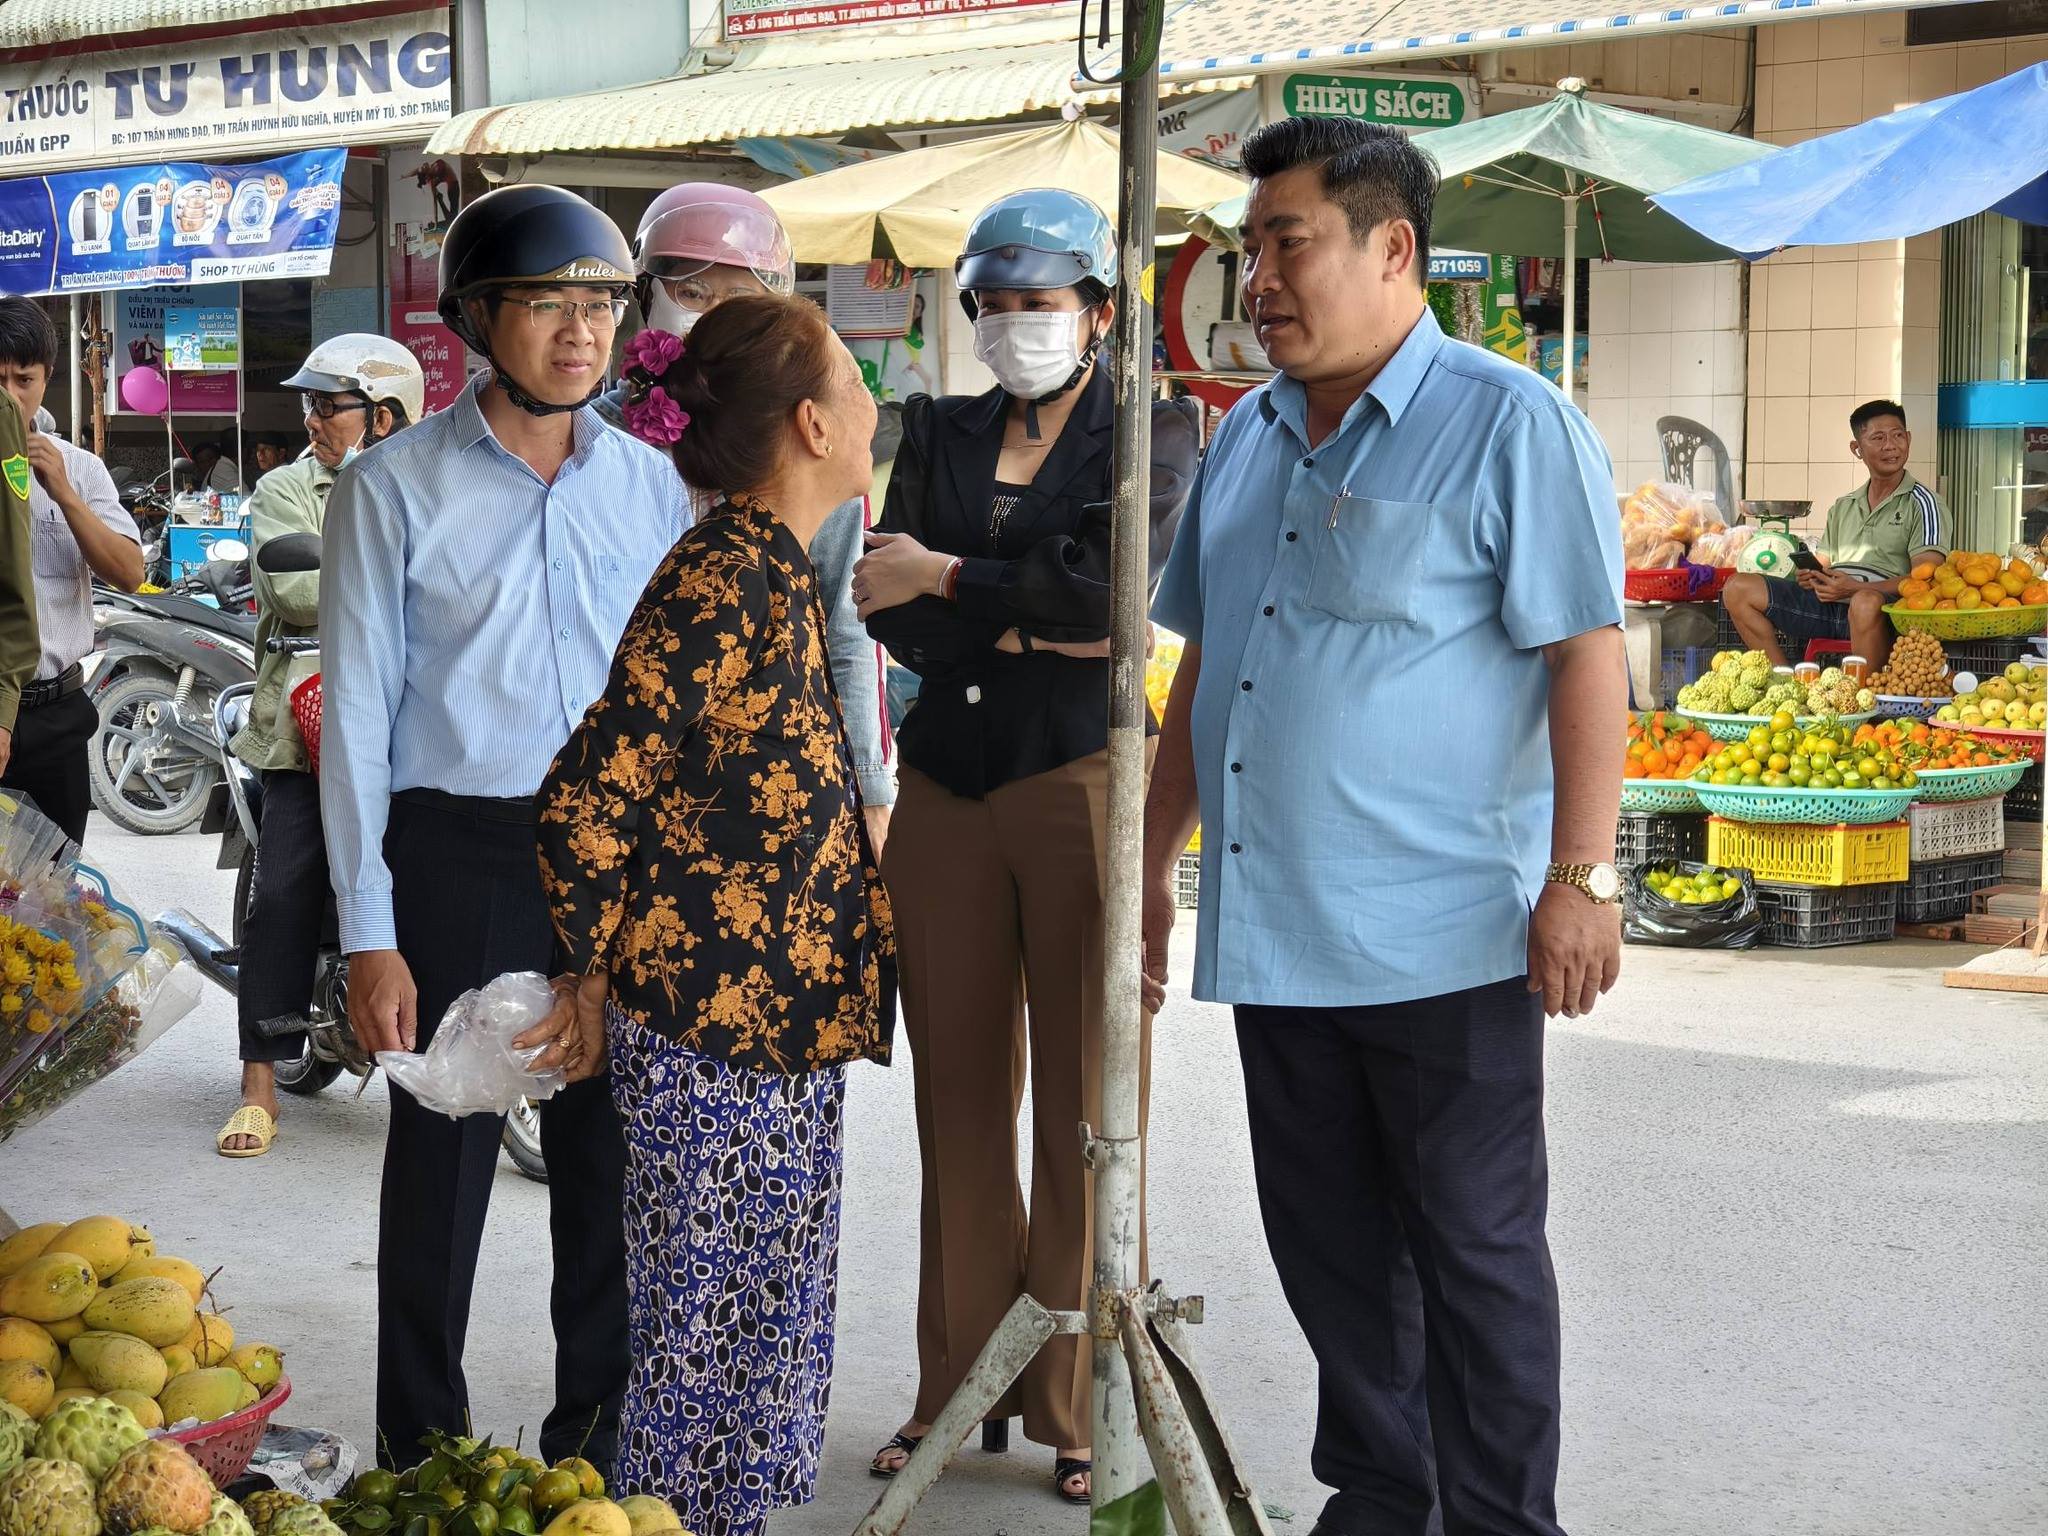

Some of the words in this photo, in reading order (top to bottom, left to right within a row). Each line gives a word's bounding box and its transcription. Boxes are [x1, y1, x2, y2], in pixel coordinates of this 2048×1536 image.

[105, 62, 197, 121] TƯ
[219, 31, 450, 109] HÙNG
[5, 70, 89, 123] THUỐC
[1374, 82, 1452, 120] SÁCH
[112, 132, 126, 145] ĐC:
[127, 132, 142, 144] 107
[212, 123, 226, 138] THỊ
[251, 114, 280, 131] HUỲNH
[333, 107, 363, 125] HUYỆN
[365, 106, 381, 121] MỸ
[0, 132, 35, 157] UẨN
[40, 134, 71, 152] GPP
[105, 189, 114, 199] 01
[200, 265, 229, 277] SHOP
[231, 264, 245, 275] TƯ
[247, 261, 275, 275] HÙNG
[555, 262, 616, 279] Andes
[128, 304, 157, 319] VIÊM
[422, 345, 436, 365] vội
[437, 346, 449, 361] vã
